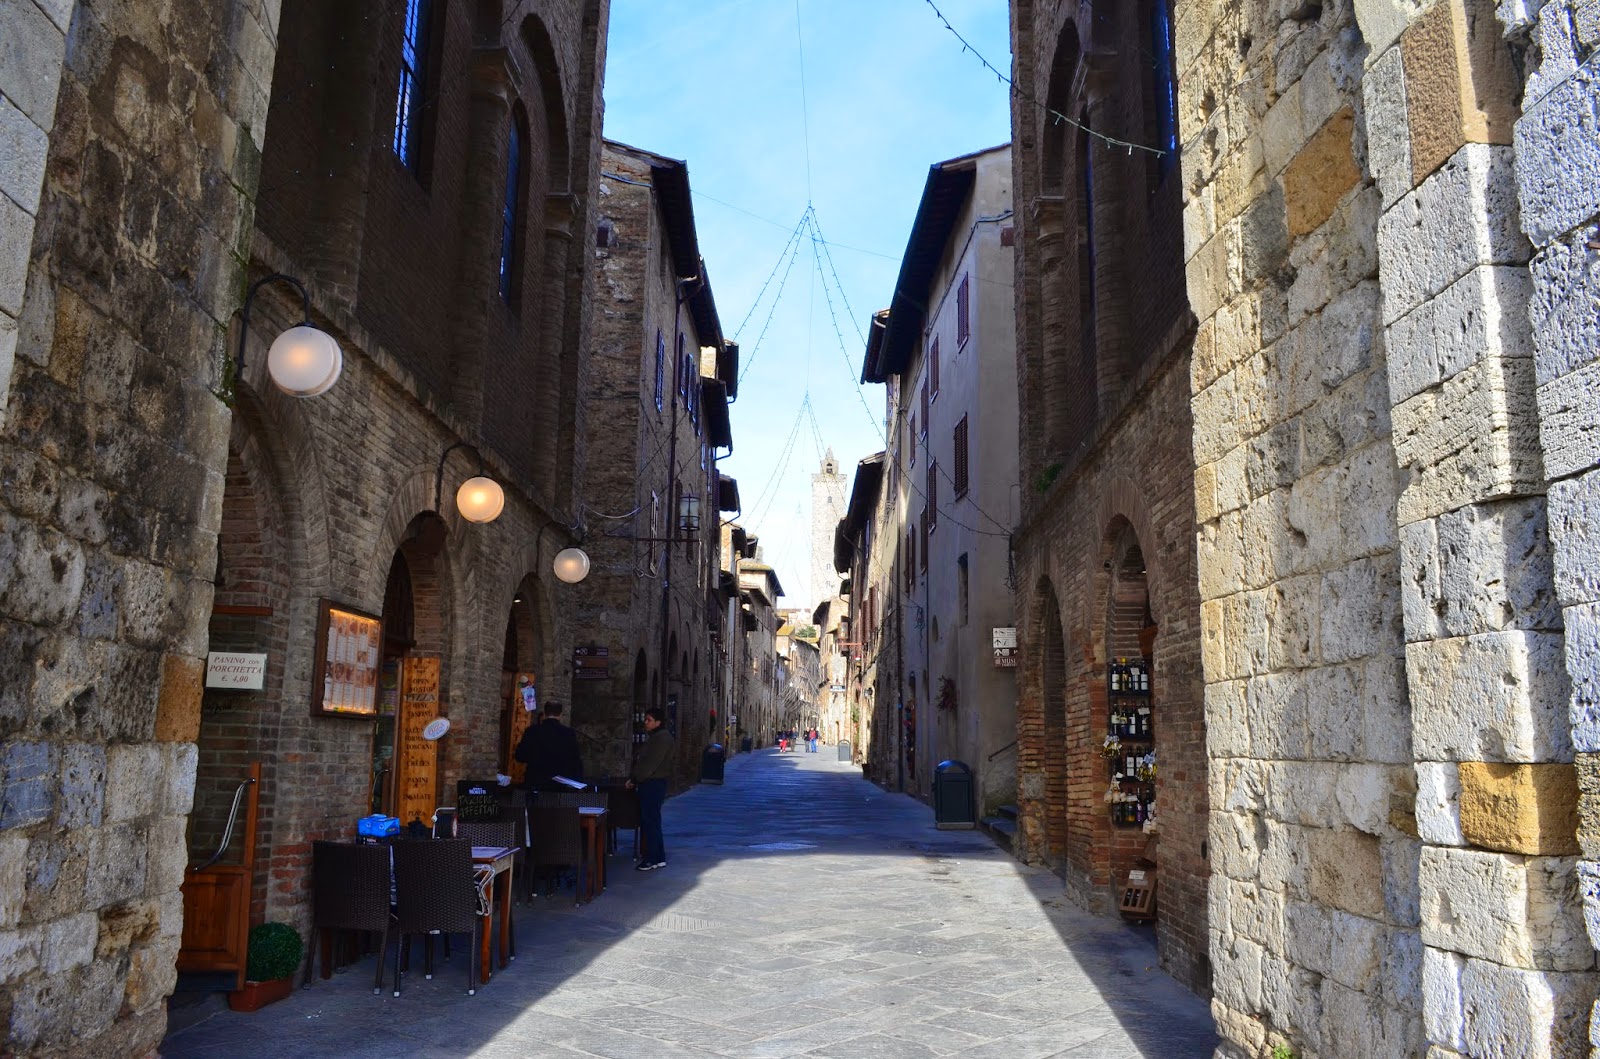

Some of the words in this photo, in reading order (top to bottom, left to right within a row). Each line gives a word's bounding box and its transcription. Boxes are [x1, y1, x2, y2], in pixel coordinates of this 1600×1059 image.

[214, 656, 246, 664] PANINO
[209, 665, 262, 674] PORCHETTA
[232, 675, 249, 683] 4,00
